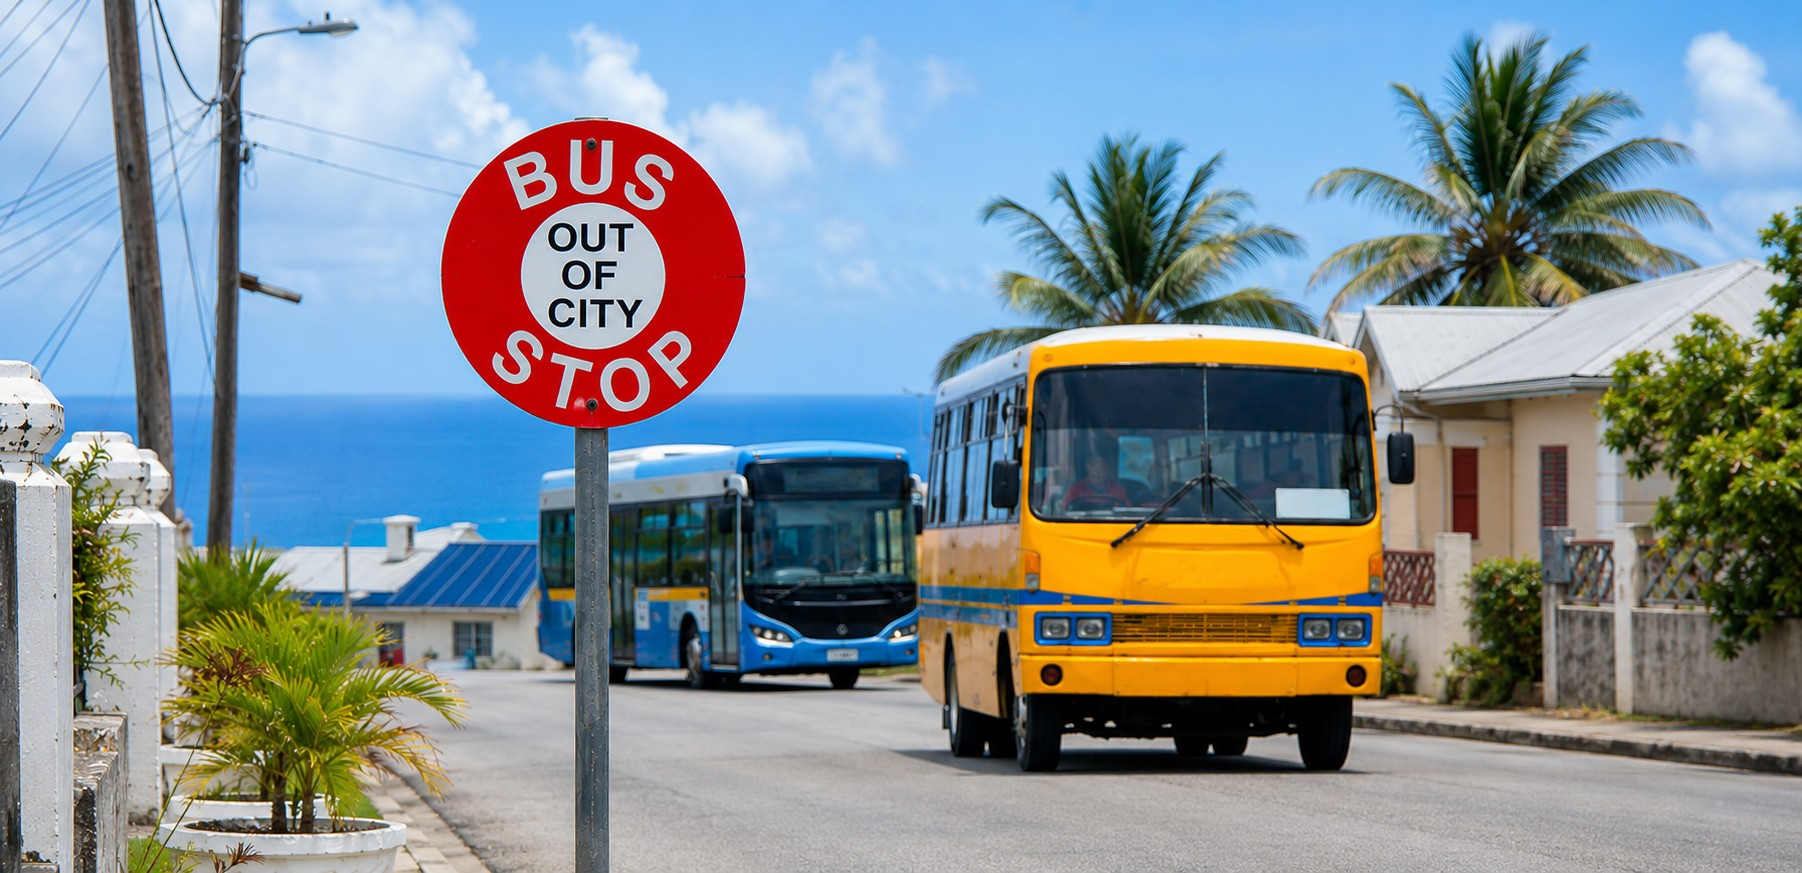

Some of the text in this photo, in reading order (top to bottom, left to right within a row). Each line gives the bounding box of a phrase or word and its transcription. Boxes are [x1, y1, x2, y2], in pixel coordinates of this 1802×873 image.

[504, 139, 675, 211] BUS
[547, 222, 634, 253] OUT
[561, 260, 618, 290] OF
[548, 297, 643, 329] CITY
[491, 329, 692, 413] STOP
